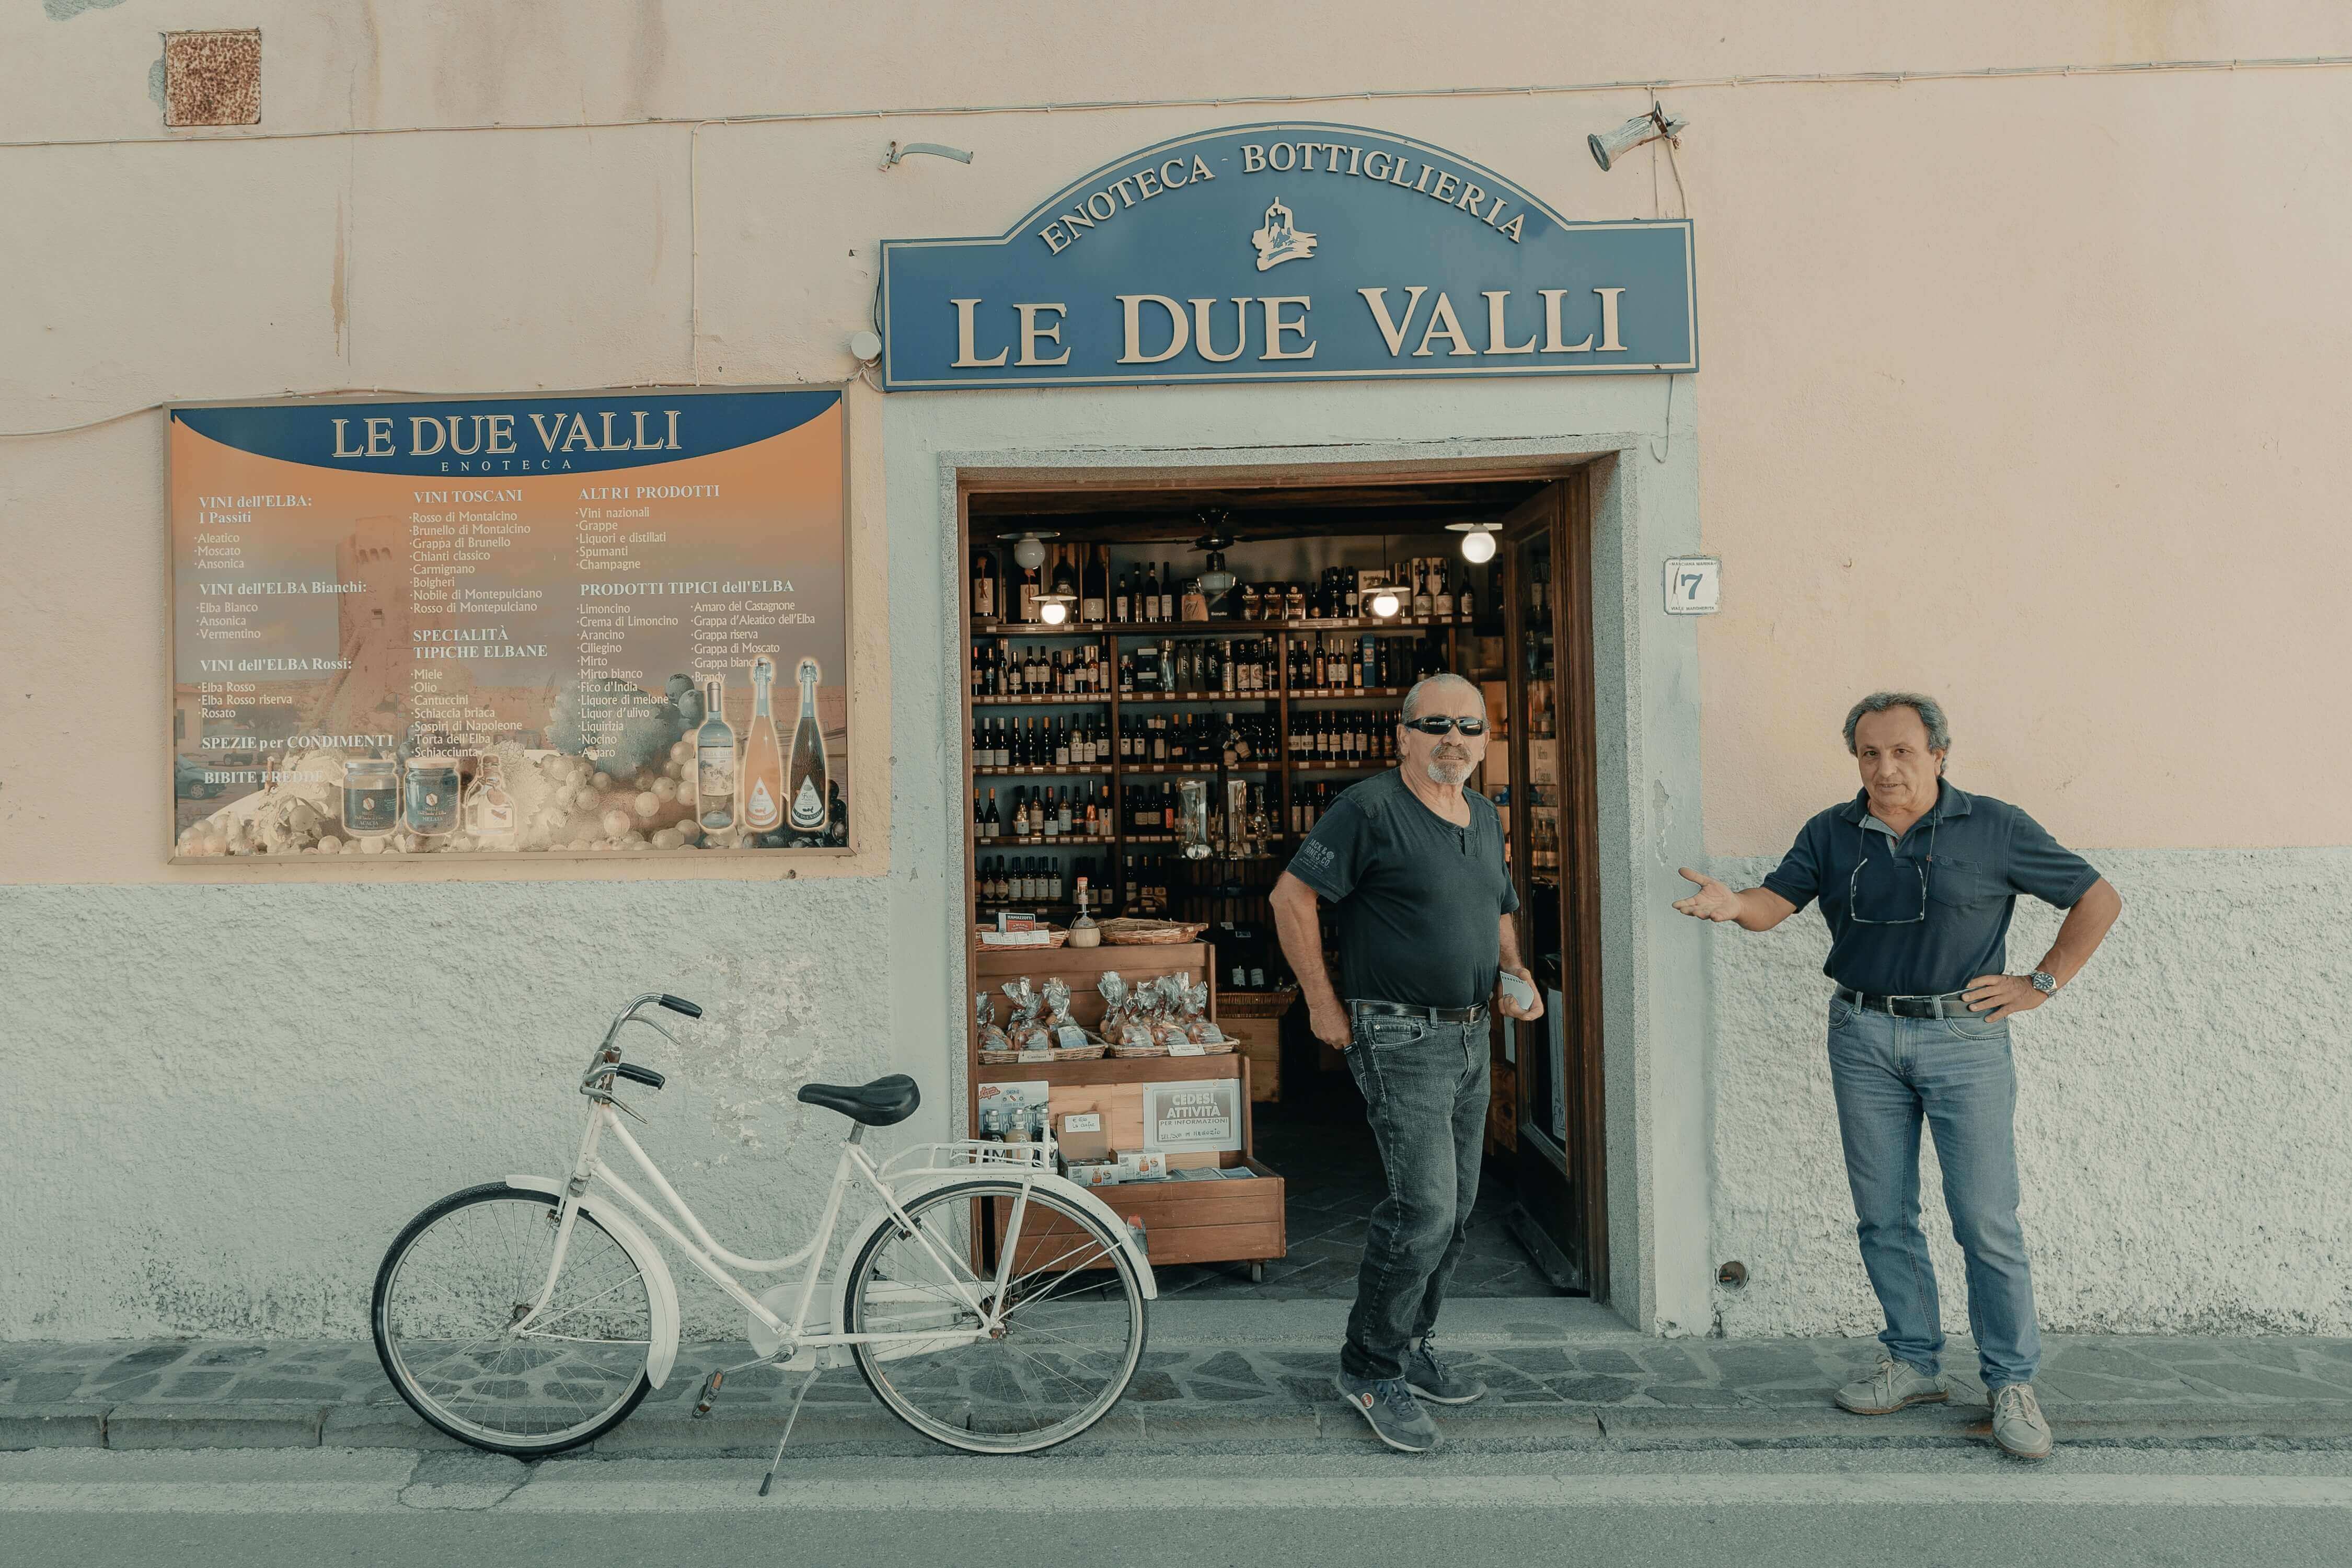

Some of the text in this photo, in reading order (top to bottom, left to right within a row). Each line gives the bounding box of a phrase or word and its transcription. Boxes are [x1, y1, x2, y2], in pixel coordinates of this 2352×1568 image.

[1037, 142, 1525, 256] ENOTECA BOTTIGLIERIA
[949, 284, 1629, 367] LE DUE VALLI
[331, 410, 682, 457] LE DUE VALLI
[442, 459, 571, 471] ENOTECA
[414, 490, 522, 503] VINI TOSCANI
[579, 485, 719, 500] ALTRI PRODOTTI
[199, 495, 312, 508] VINI dell'ELBA:
[199, 512, 251, 523] I Passiti
[412, 511, 517, 522] Rosso di Montalcino
[579, 508, 649, 518] Vini nazionali
[413, 524, 530, 535] Brunello di Montalcino
[580, 521, 617, 533] Grappe
[198, 534, 239, 543] Aleatico
[413, 537, 510, 550] Grappa di Brunello
[580, 534, 615, 545] Liquori
[629, 533, 666, 543] distillati
[198, 547, 240, 556] Moscato
[413, 551, 490, 561] Chianti classico
[580, 546, 628, 558] Spumanti
[198, 559, 244, 569] Ansonica
[413, 564, 475, 575] Carmignano
[580, 559, 640, 571] Champagne
[413, 577, 454, 587] Bolgheri
[1681, 573, 1703, 599] 7
[200, 581, 366, 595] VINI dell'ELBA Bianchi:
[580, 581, 794, 596] PRODOTTI TIPICI dell'ELBA
[413, 589, 542, 601] Nobile di Montepulciano
[200, 603, 258, 613] Elba Bianco
[413, 602, 537, 614] Rosso di Montepulciano
[580, 603, 630, 614] Limoncino
[694, 601, 794, 612] Amaro del Castagnone
[200, 616, 246, 625] Ansonica
[580, 615, 678, 627] Crema di Limoncino
[694, 614, 815, 627] Grappa d'Aleatico dell'Elba
[200, 629, 261, 639] Vermentino
[413, 626, 508, 642] SPECIALITÀ
[581, 630, 624, 640] Arancino
[694, 630, 758, 641] Grappa riserva
[414, 645, 547, 659] TIPICHE ELBANE
[581, 643, 621, 654] Ciliegino
[694, 643, 779, 655] Grappa di Moscato
[201, 659, 352, 672] VINI dell'ELBA Rossi:
[581, 656, 607, 666] Mirto
[695, 658, 758, 670] Grappa bianca
[414, 670, 442, 679] Miele
[581, 669, 642, 679] Mirto bianco
[695, 672, 726, 683] Brandy
[202, 683, 255, 692] Elba Rosso
[414, 683, 436, 692] Olio
[581, 682, 638, 692] Fico d'India
[202, 695, 292, 705] Elba Rosso riserva
[414, 696, 468, 706] Cantuccini
[581, 695, 668, 706] Liquore di melone
[202, 709, 235, 718] Rosato
[414, 708, 494, 719] Schiaccia briaca
[581, 708, 649, 719] Liquor d'ulivo
[414, 720, 522, 733] Sospiri di Napoleone
[581, 721, 624, 733] Liquirizia
[203, 735, 393, 752] SPEZIE per CONDIMENTI
[415, 734, 490, 744] Torta dell'Elba
[582, 734, 617, 744] Nocino
[414, 747, 478, 757] Schiacciunta
[204, 770, 323, 784] BIBITE FREDDE
[1309, 838, 1328, 855] JACK &
[1172, 1092, 1214, 1105] CEDESI
[1167, 1102, 1220, 1119] ATTIVITÀ
